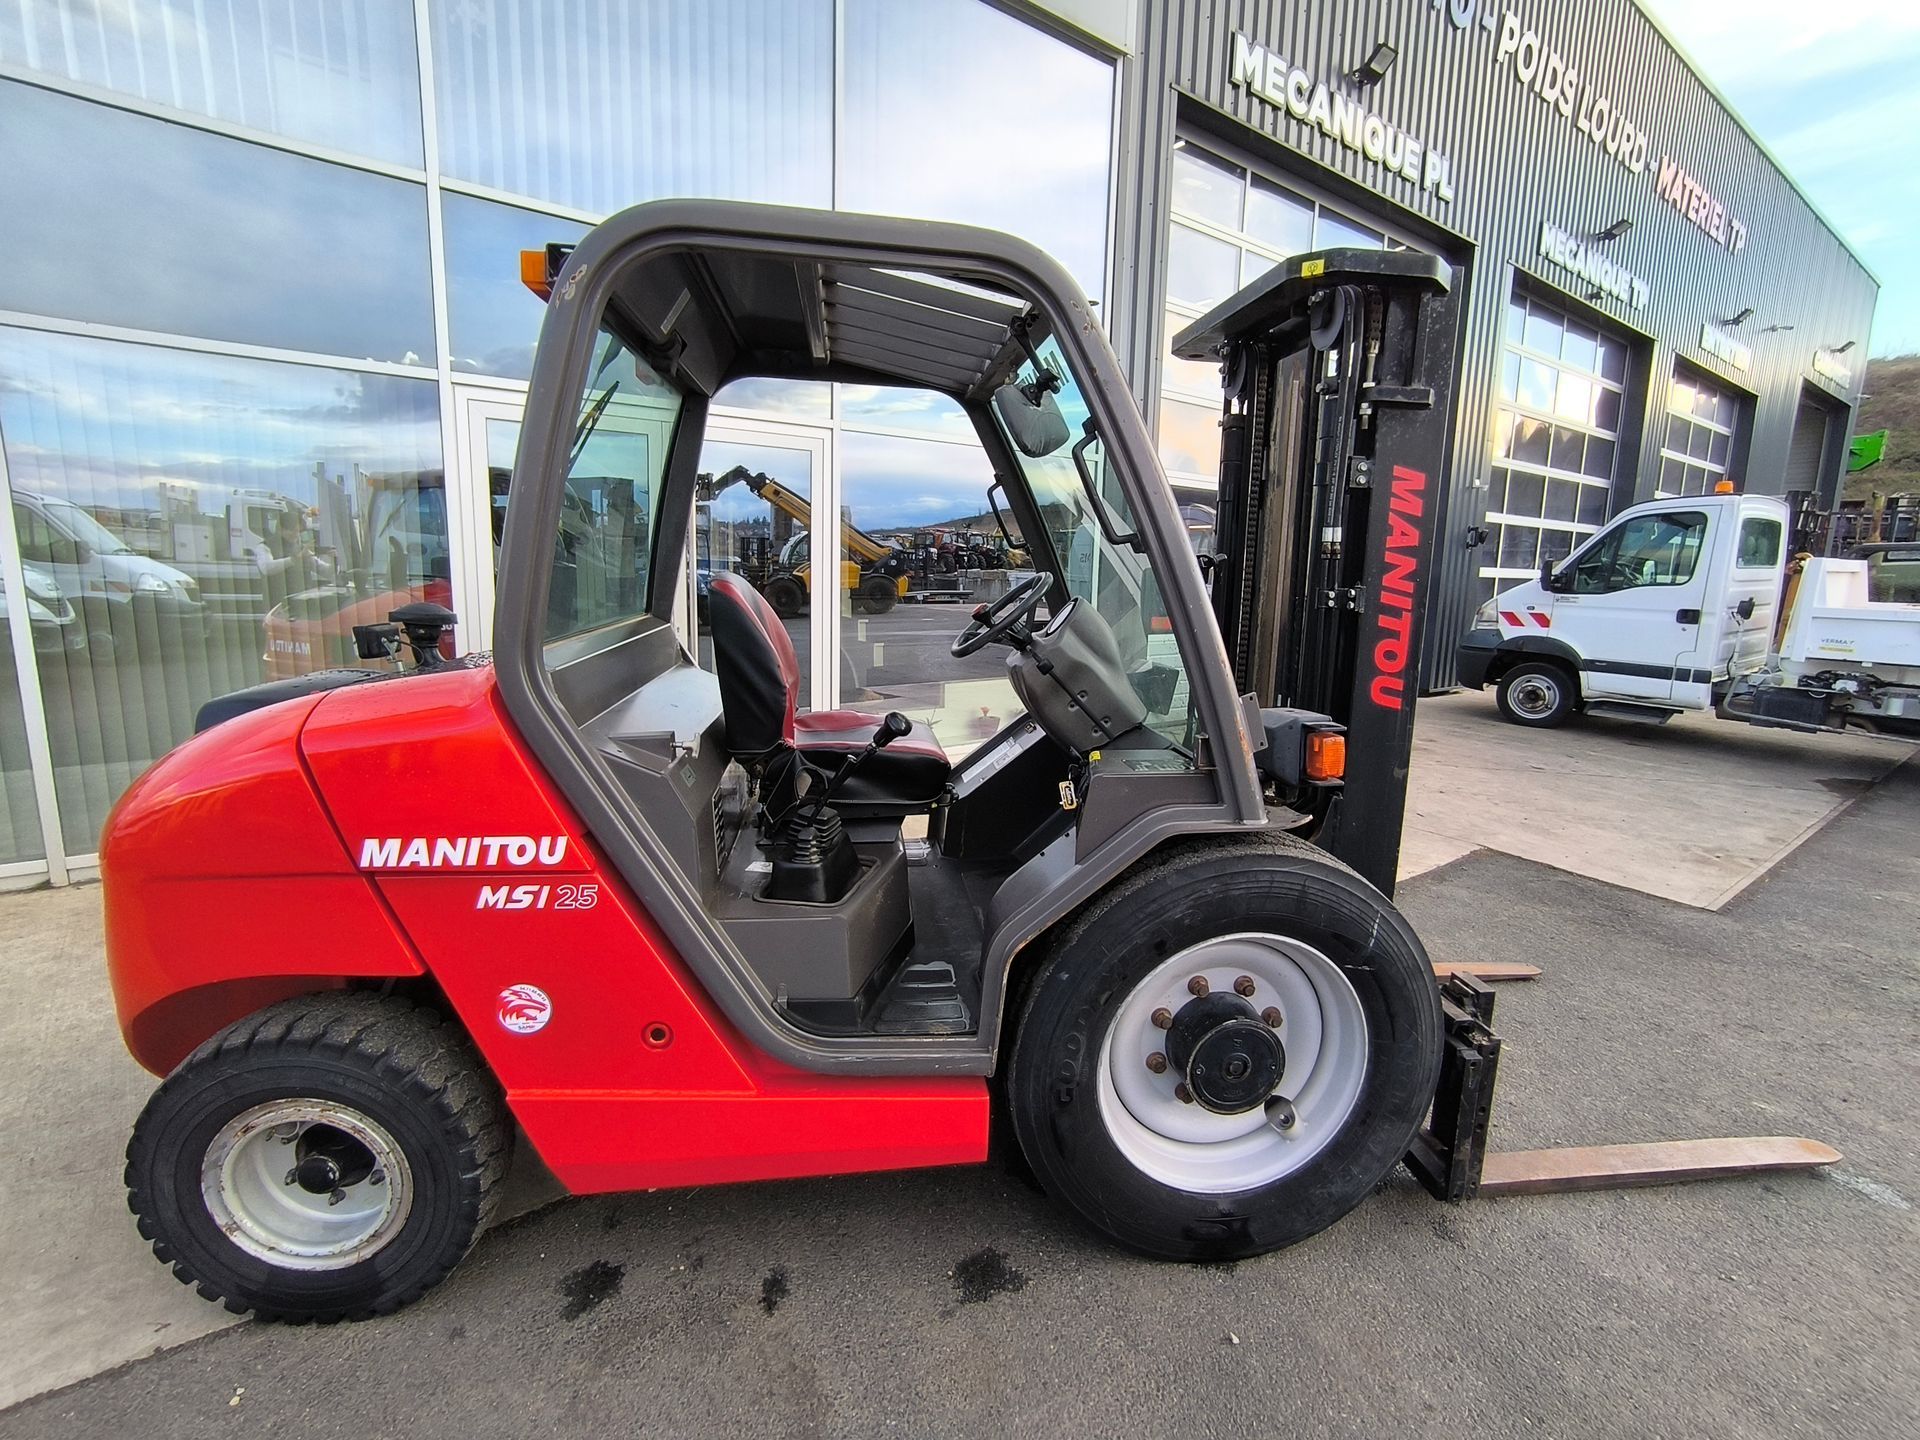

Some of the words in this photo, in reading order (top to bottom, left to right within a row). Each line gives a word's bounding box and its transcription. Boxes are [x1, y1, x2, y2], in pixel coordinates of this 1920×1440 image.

[1232, 30, 1422, 183] MECANIQUE
[1422, 149, 1454, 203] PL
[1497, 10, 1578, 117] POIDS
[1576, 83, 1647, 174] LOURD
[1656, 154, 1725, 247] MATERIEL
[1727, 218, 1748, 256] TP
[1538, 221, 1632, 303] MECANIQUE
[1371, 465, 1426, 710] MANITOU
[360, 836, 569, 868] MANITOU
[476, 885, 551, 909] MSI
[554, 884, 599, 910] 25
